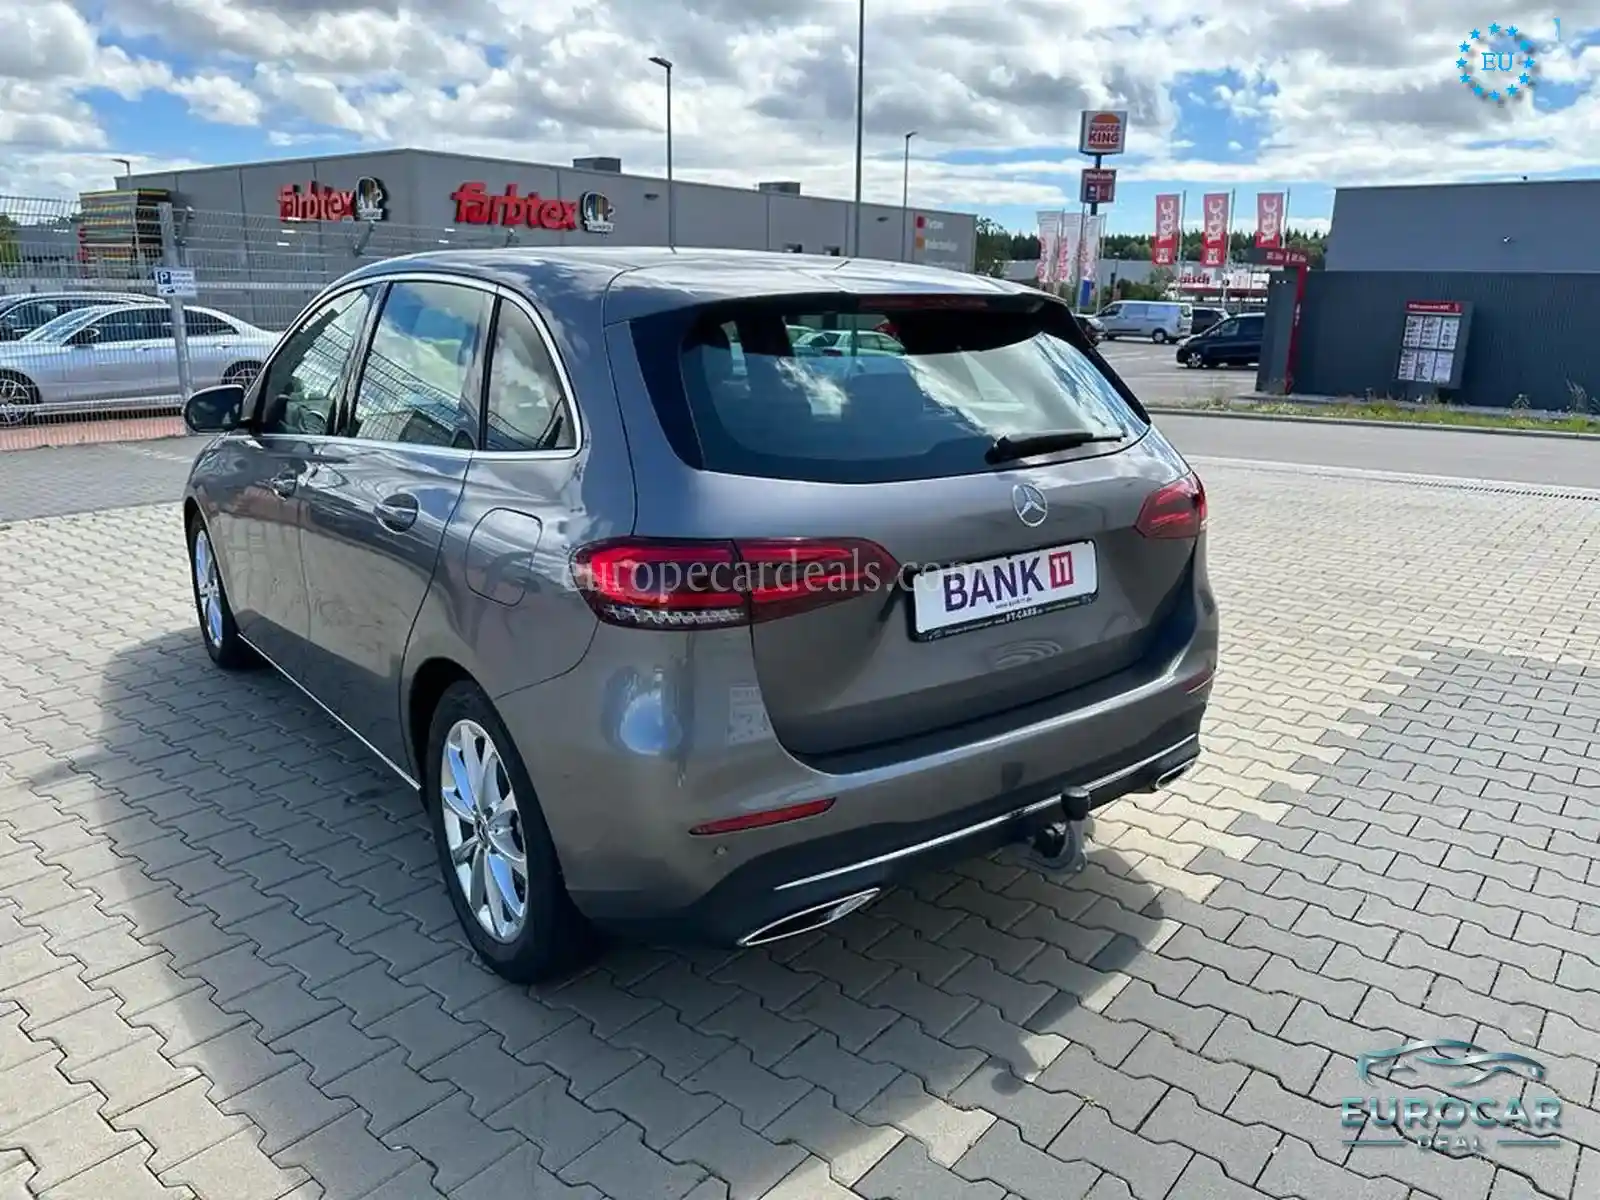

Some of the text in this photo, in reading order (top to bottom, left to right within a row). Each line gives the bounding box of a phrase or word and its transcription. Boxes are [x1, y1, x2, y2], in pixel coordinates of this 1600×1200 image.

[1088, 132, 1120, 143] KING
[1207, 199, 1223, 244] KFC
[943, 553, 1072, 613] BANK 11
